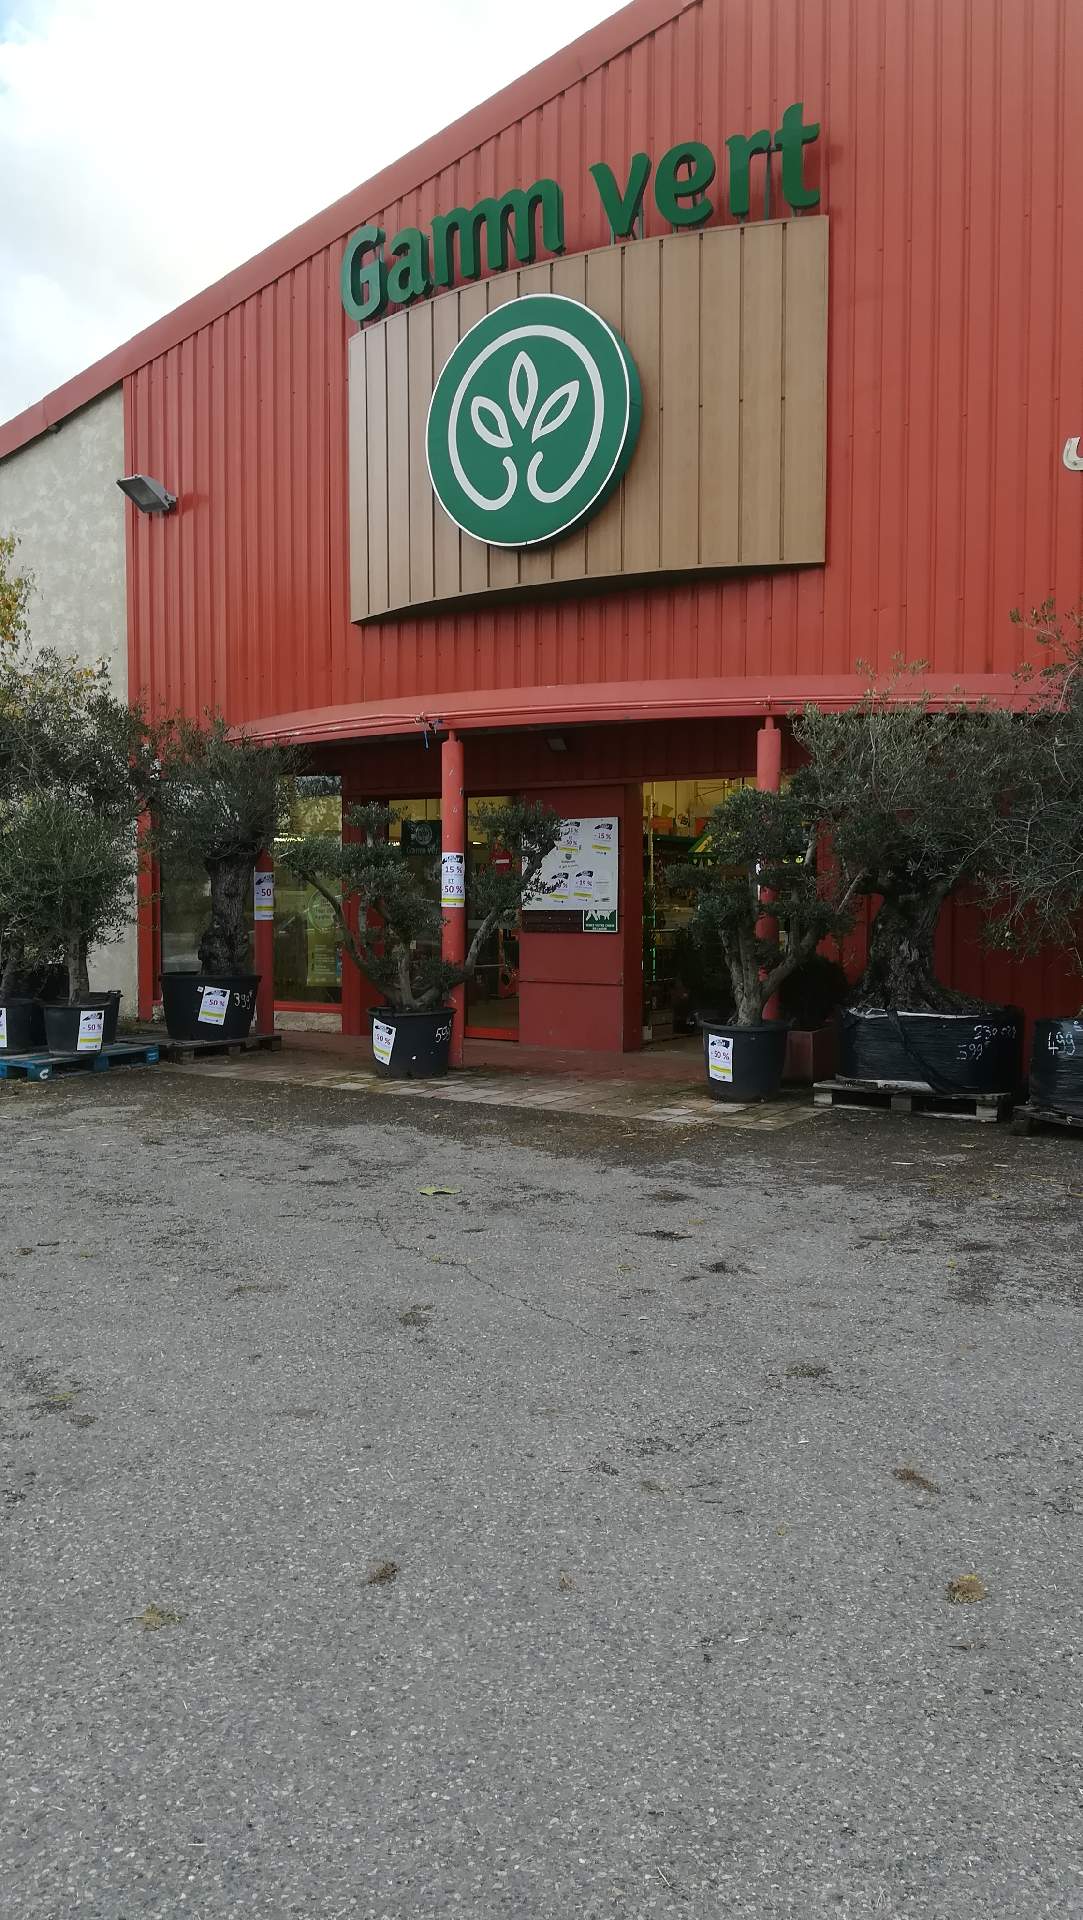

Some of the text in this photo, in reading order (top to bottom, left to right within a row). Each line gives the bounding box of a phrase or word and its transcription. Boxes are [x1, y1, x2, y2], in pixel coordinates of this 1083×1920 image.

[340, 101, 821, 323] Gamm vert
[261, 889, 272, 897] 50
